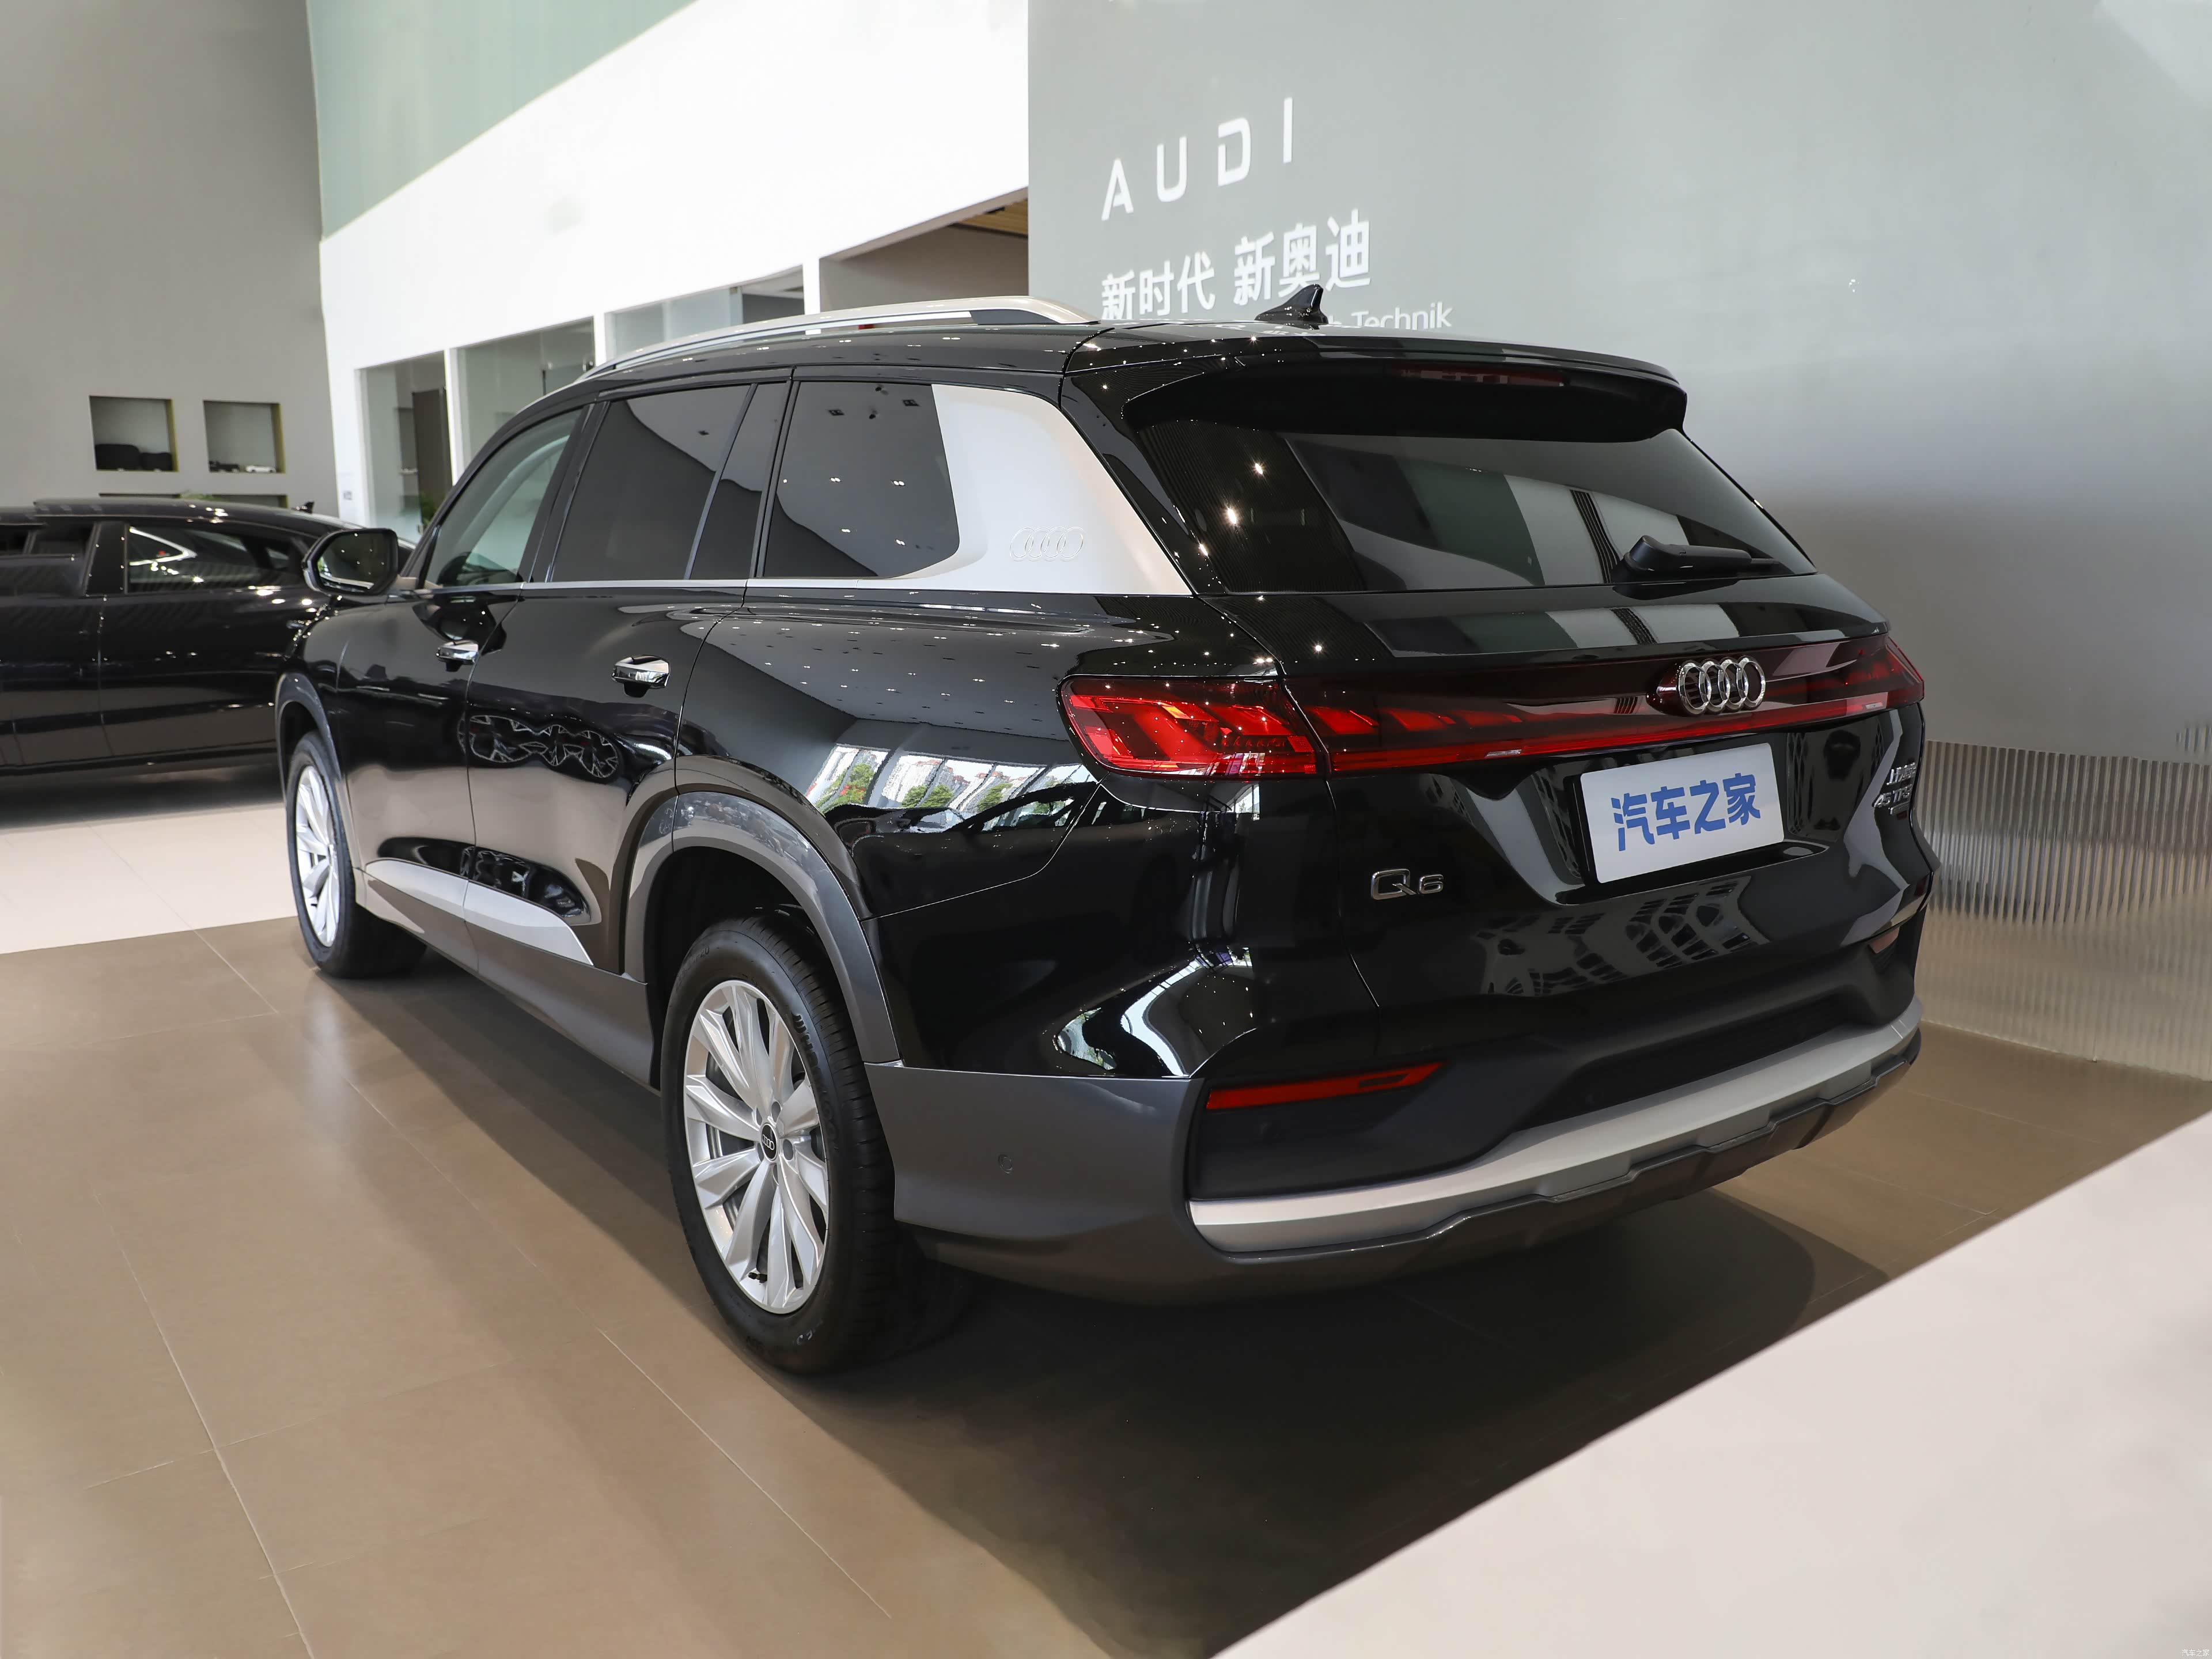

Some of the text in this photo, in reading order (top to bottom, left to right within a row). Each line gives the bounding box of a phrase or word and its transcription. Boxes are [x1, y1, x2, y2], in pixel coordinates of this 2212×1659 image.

[1101, 97, 1294, 221] AUDI
[1101, 208, 1371, 320] 新时代 新奥迪
[1611, 773, 1762, 852] 汽车之家
[1371, 868, 1444, 900] Q6
